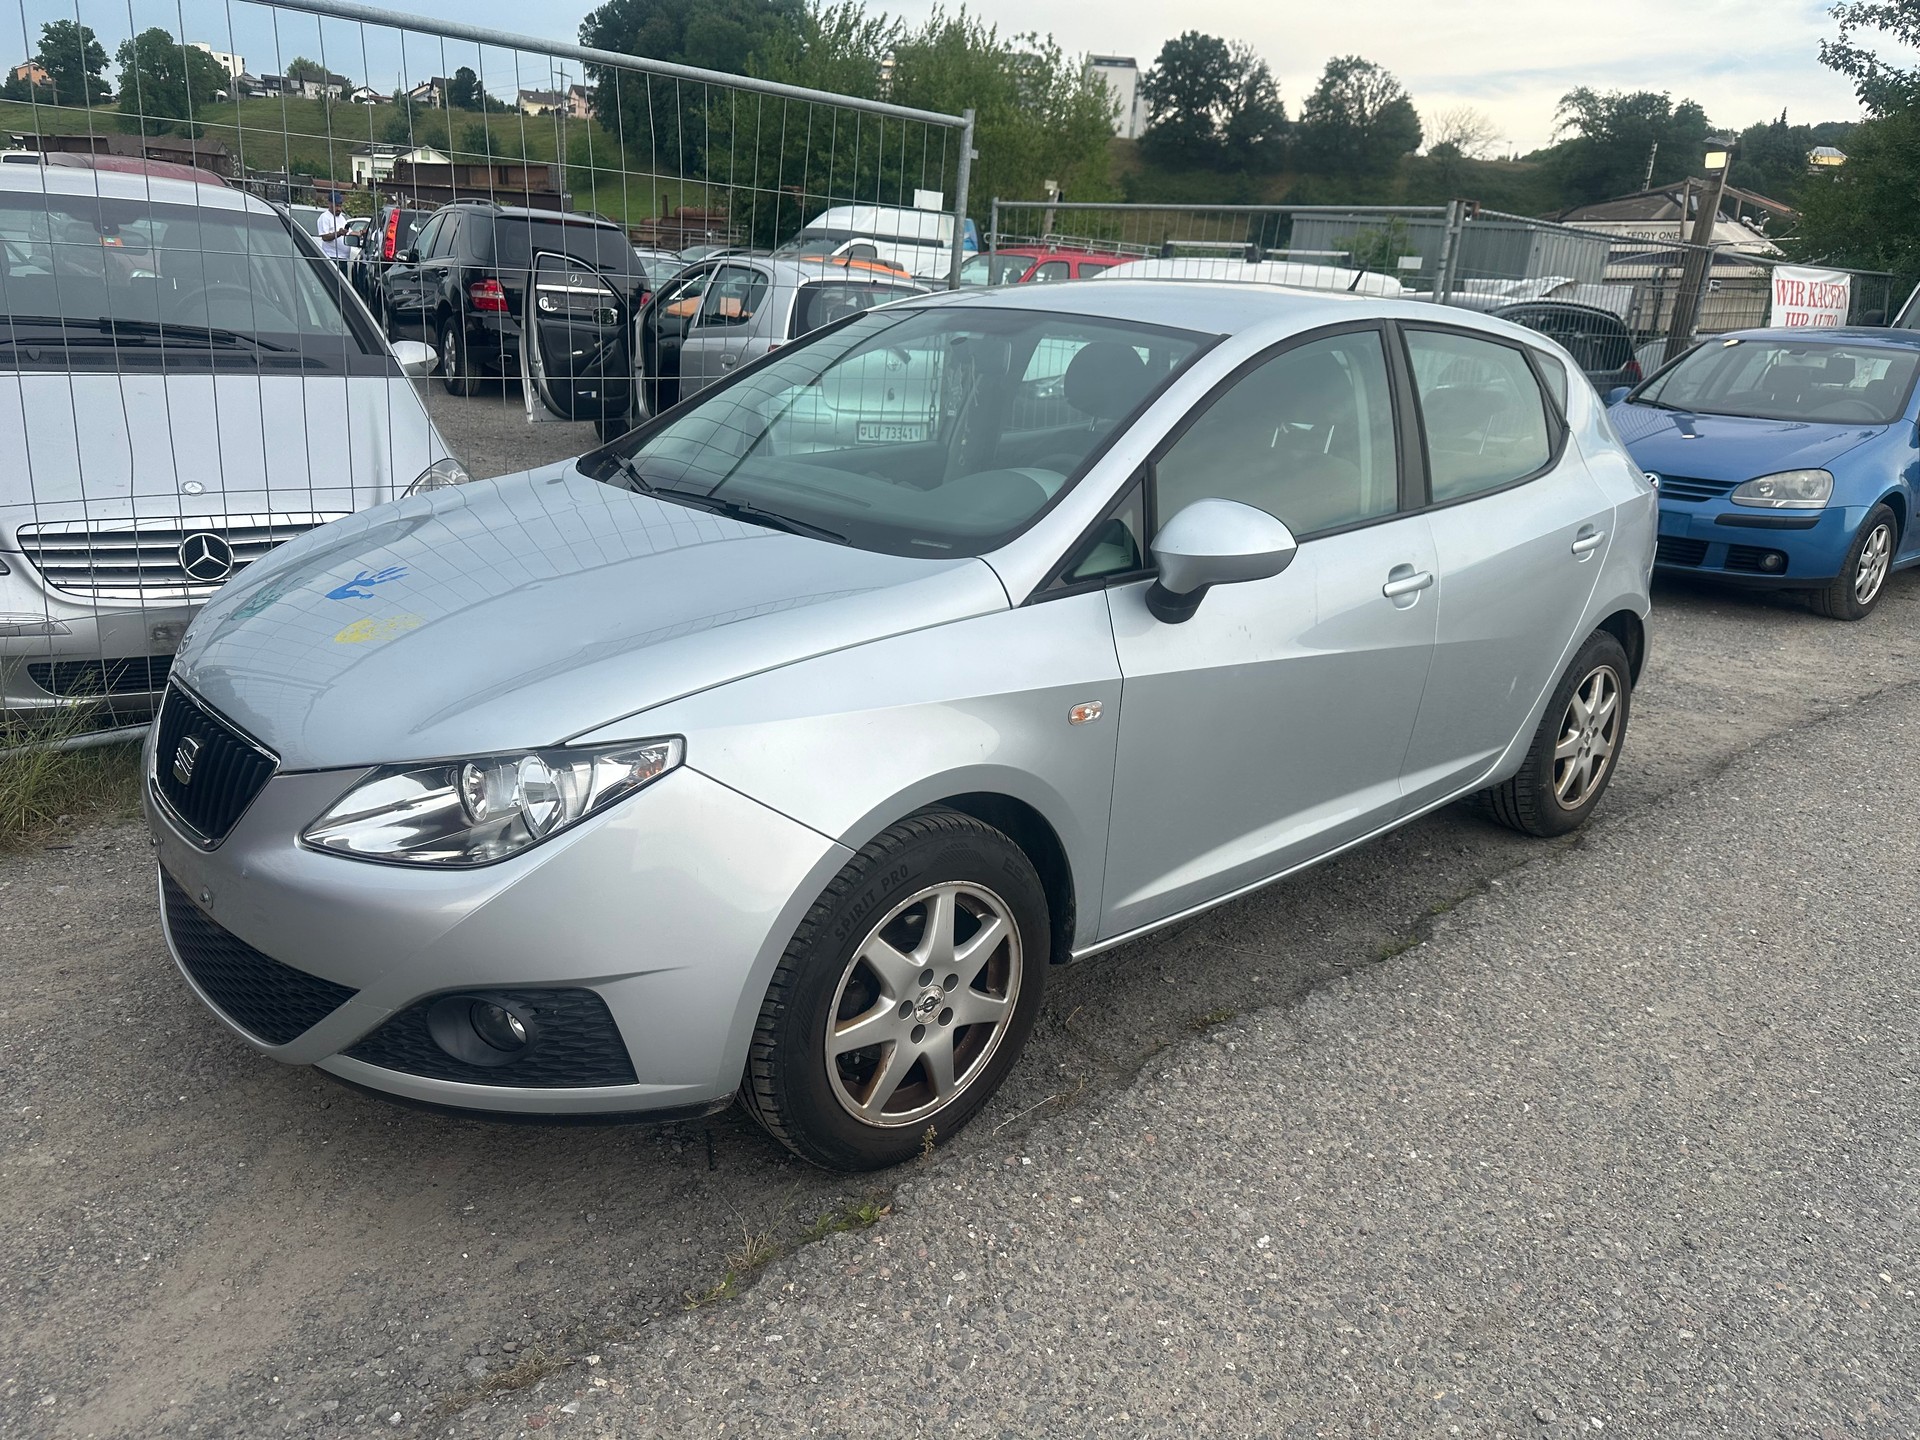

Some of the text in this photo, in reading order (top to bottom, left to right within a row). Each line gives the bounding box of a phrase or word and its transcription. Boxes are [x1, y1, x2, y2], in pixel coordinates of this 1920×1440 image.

[1658, 231, 1680, 240] ONE
[1775, 279, 1848, 310] WIR KAUFEN
[834, 863, 909, 943] SPIRIT PRO
